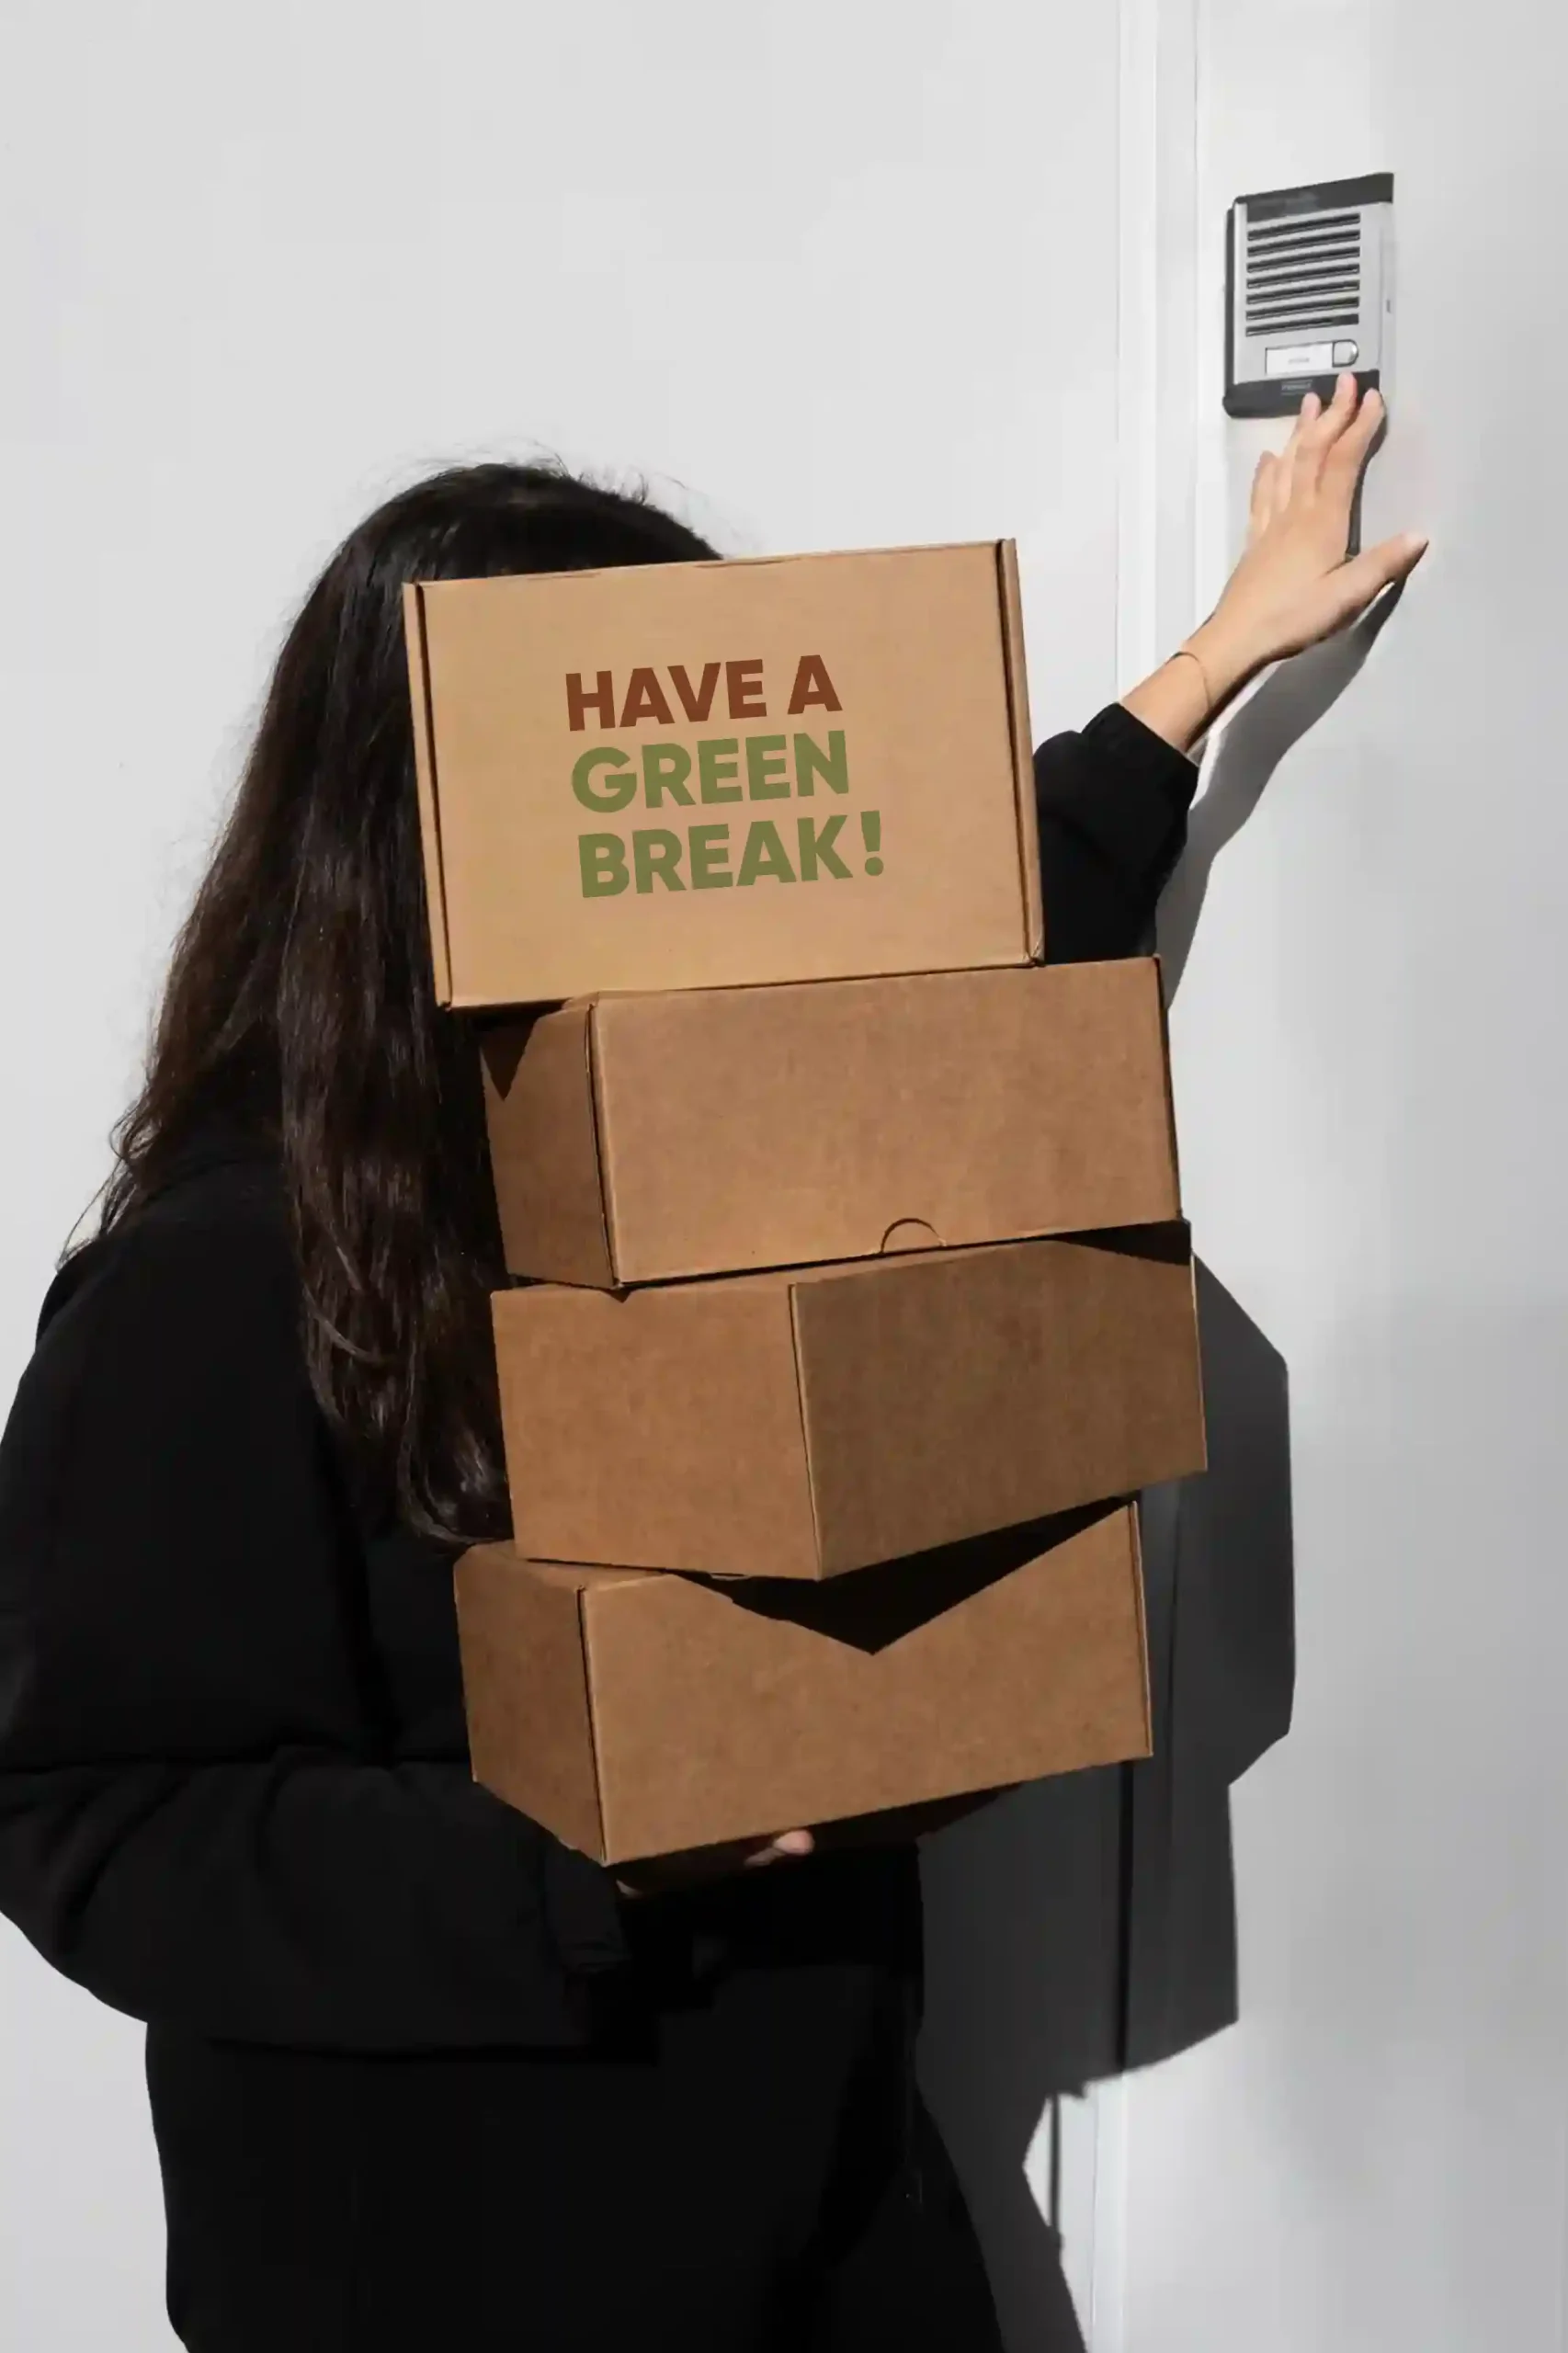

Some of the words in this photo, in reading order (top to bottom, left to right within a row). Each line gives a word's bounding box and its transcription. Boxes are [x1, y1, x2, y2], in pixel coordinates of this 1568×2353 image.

[565, 659, 767, 732] HAVE
[788, 654, 843, 715] A
[572, 730, 849, 813] GREEN
[578, 810, 884, 898] BREAK!
